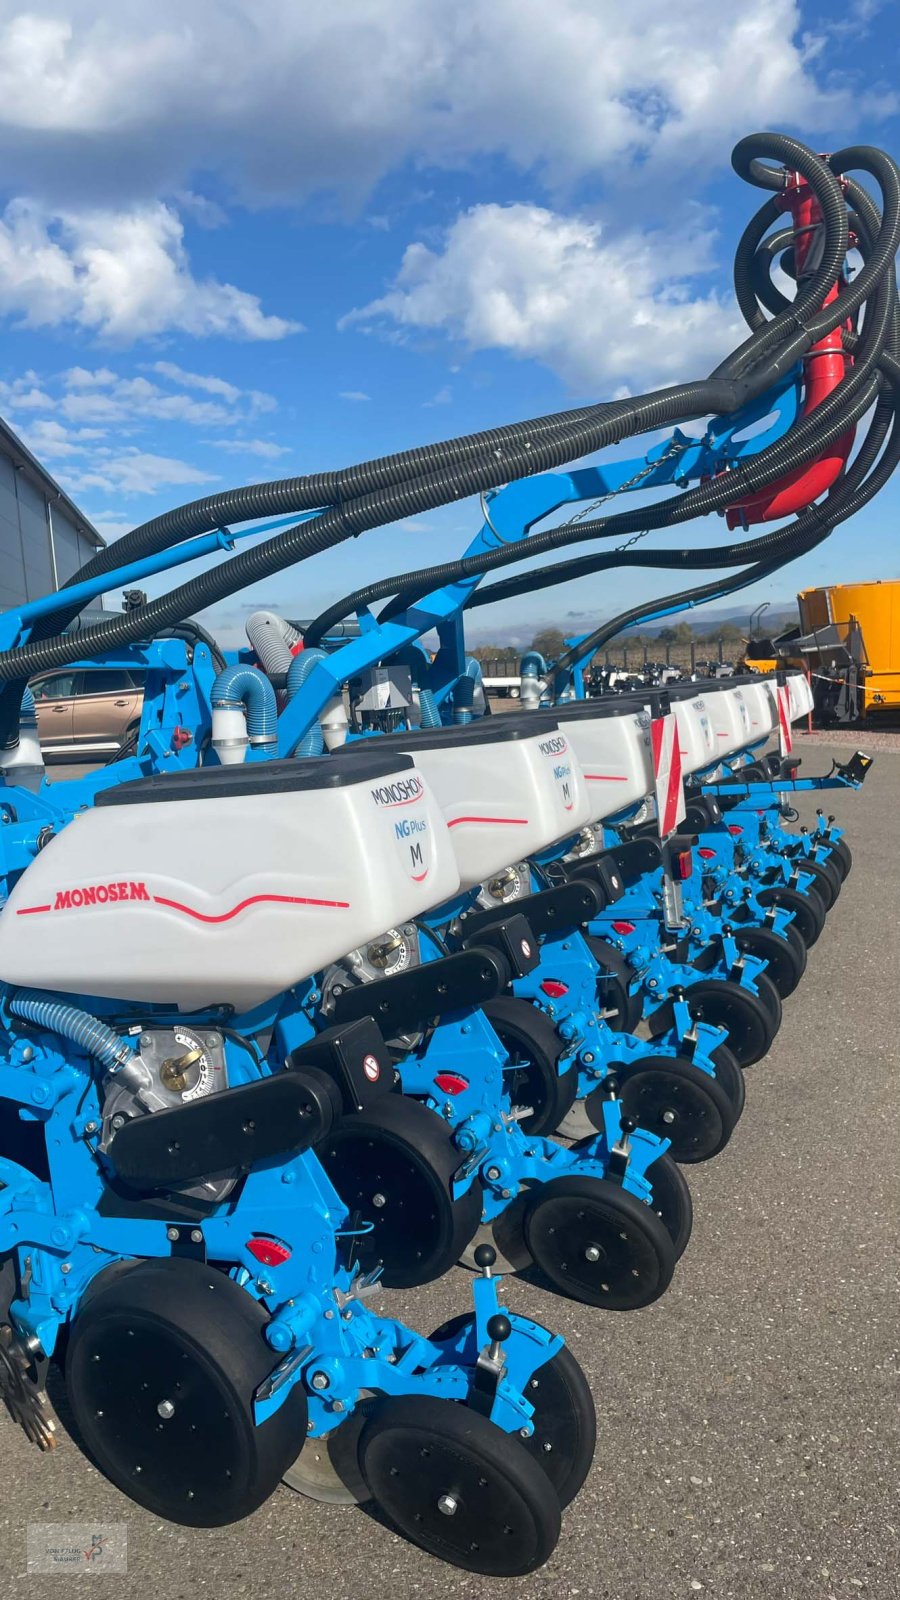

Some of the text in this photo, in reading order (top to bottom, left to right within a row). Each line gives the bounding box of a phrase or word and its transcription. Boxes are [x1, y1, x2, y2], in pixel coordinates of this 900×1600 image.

[371, 777, 424, 805] MONOSHOX
[562, 783, 570, 801] M
[395, 819, 426, 840] NG Plus
[410, 842, 423, 868] M
[54, 882, 150, 909] MONOSEM
